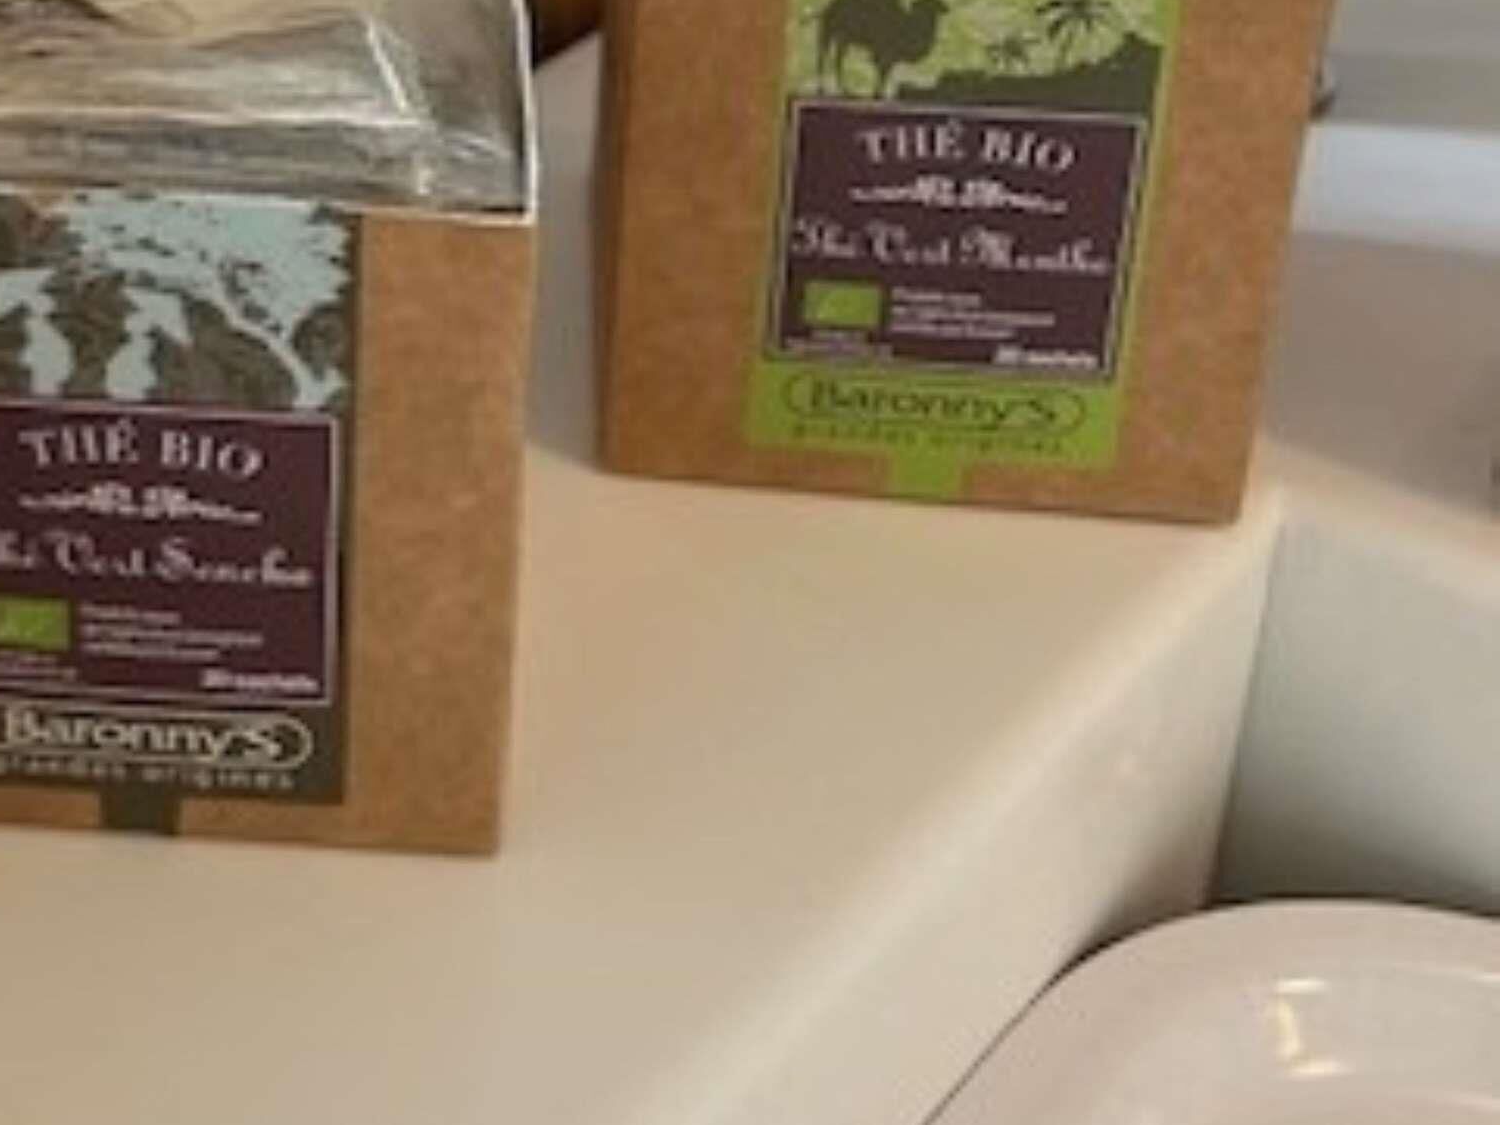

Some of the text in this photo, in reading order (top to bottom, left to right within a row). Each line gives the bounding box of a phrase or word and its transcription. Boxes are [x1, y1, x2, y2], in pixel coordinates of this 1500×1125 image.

[858, 119, 1078, 175] THÉ BIO
[18, 417, 265, 481] THÉ BIO
